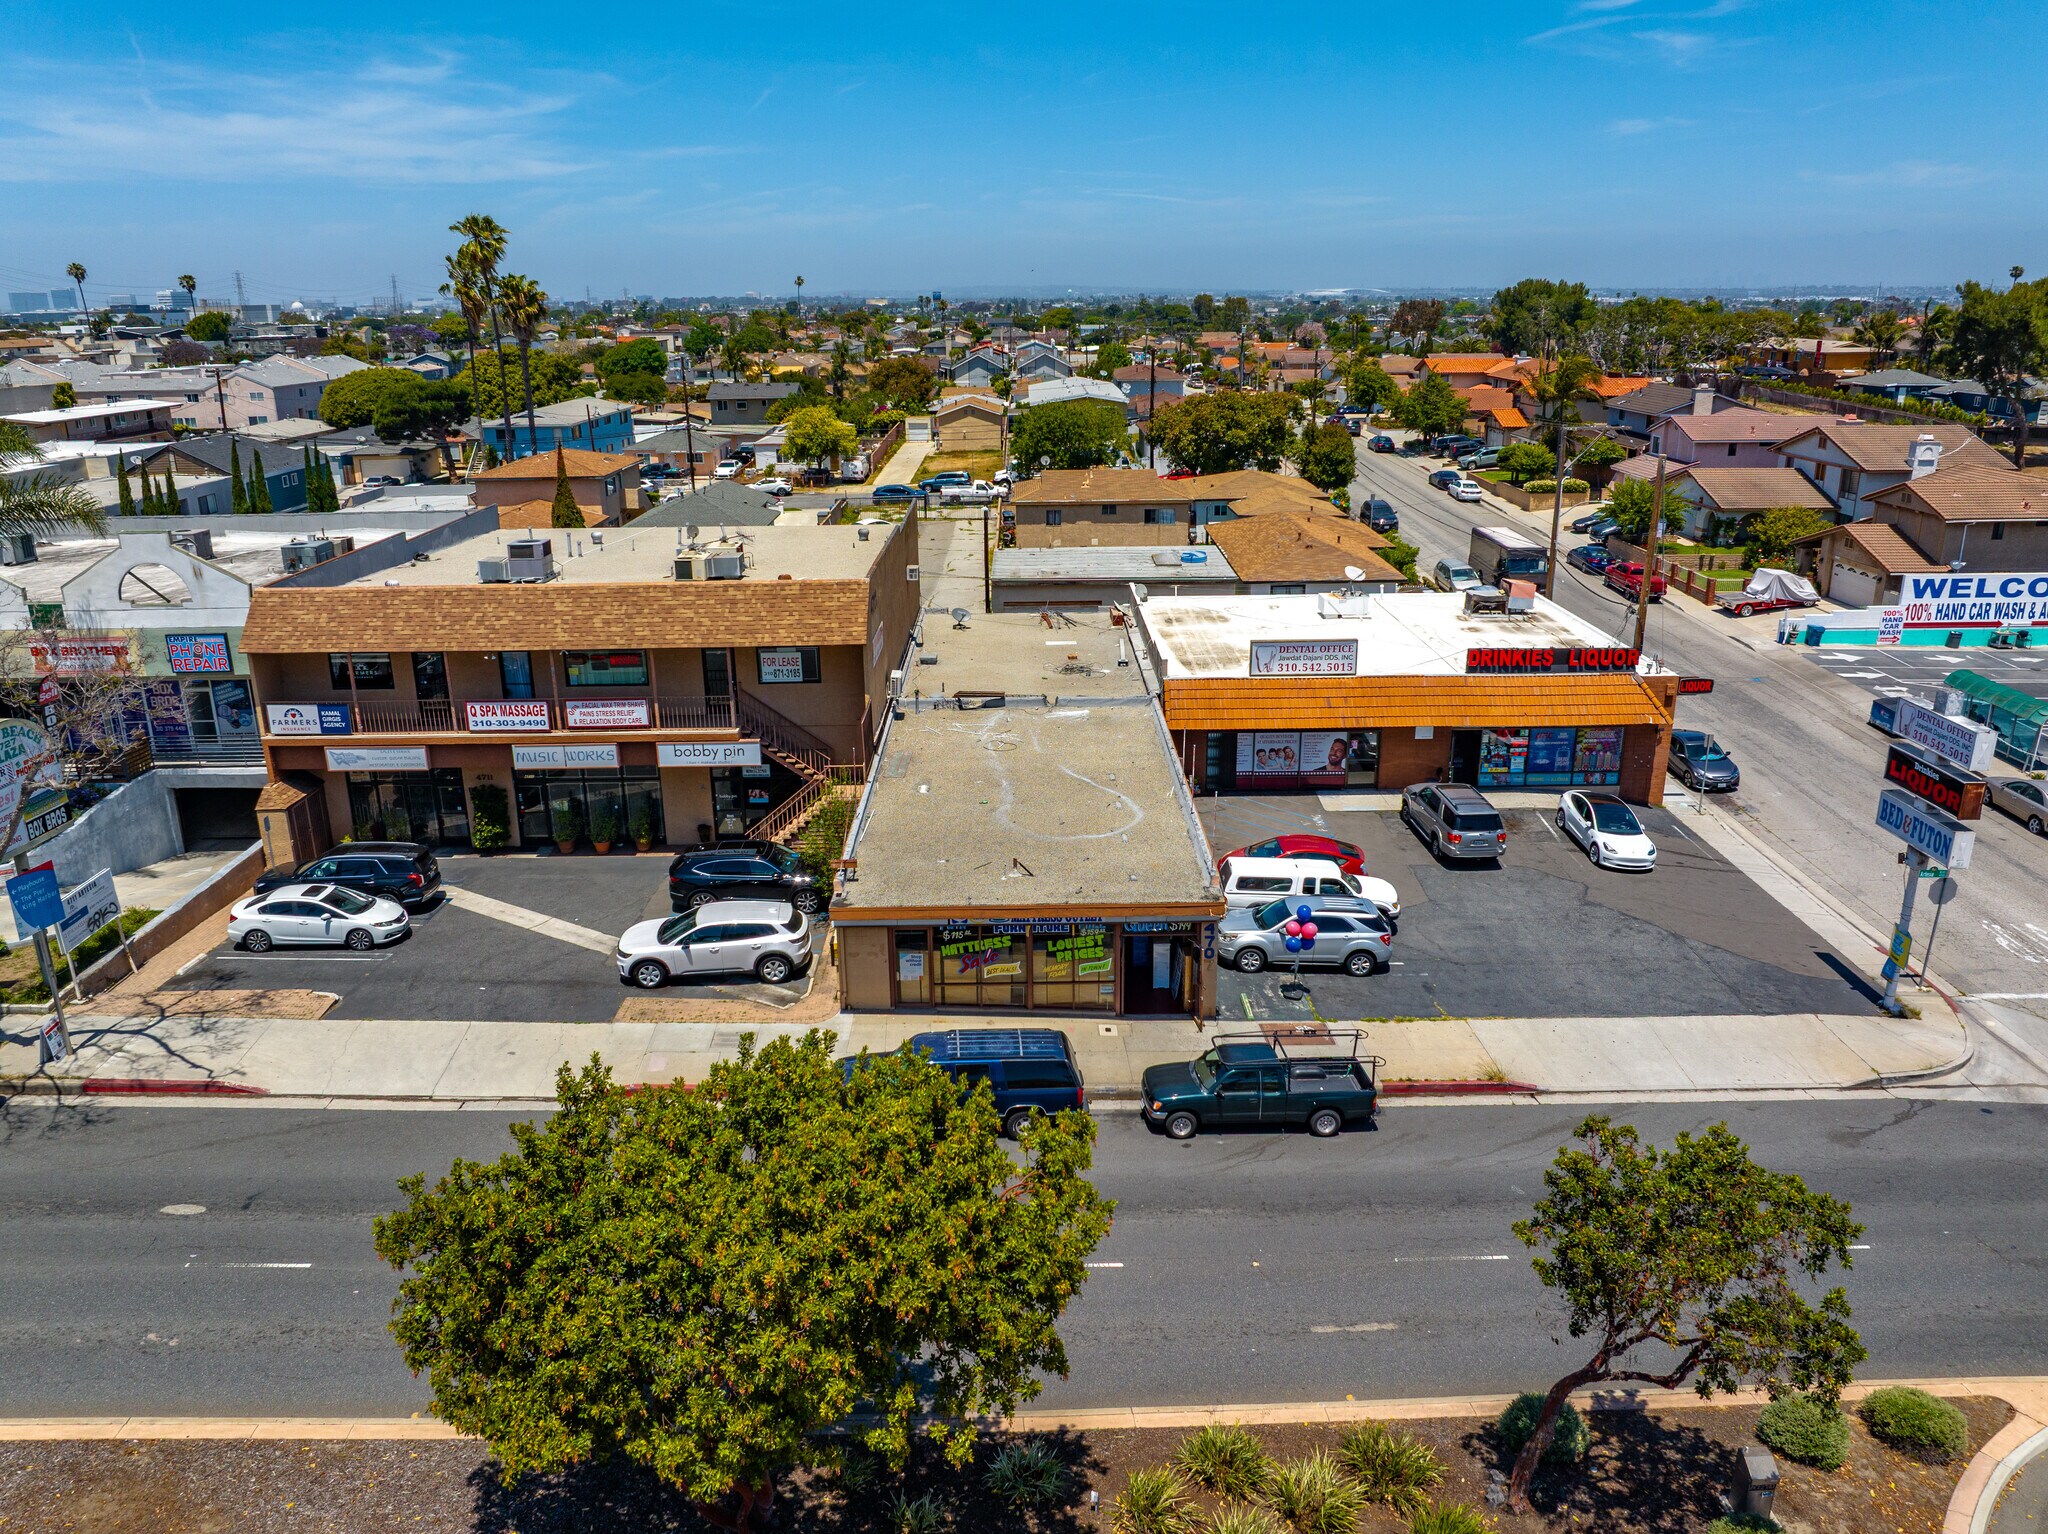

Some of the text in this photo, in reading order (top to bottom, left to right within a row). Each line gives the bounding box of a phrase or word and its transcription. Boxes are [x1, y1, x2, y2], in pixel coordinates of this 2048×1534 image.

[1905, 603, 1932, 621] 100%
[1935, 603, 1967, 621] HAND
[1968, 602, 1992, 620] CAR
[1993, 602, 2027, 620] WASH
[2028, 602, 2036, 619] &
[169, 643, 227, 656] PHONE
[1279, 645, 1354, 653] DENTAL OFFICE
[173, 657, 229, 671] REPAIR
[762, 657, 800, 667] FOR LEASE
[1468, 649, 1640, 667] DRINKIES LIQUOR
[773, 668, 801, 679] 871-3185
[1277, 663, 1353, 672] 310.542.5015
[39, 687, 58, 701] Sell
[152, 683, 175, 695] BOX
[1680, 680, 1713, 692] LIQUOR
[470, 704, 546, 718] Q SPA MASSAGE
[272, 719, 318, 727] FARMERS
[471, 719, 547, 727] 310-303-9490
[1916, 709, 1945, 731] DENTAL
[1946, 724, 1974, 744] OFFICE
[673, 744, 745, 760] bobby pin
[1912, 729, 1970, 765] 310.542.5015
[516, 749, 615, 763] MUSIC WORKS
[1914, 761, 1940, 781] Drinkies
[1889, 759, 1961, 811] LIQUOR
[28, 819, 45, 840] BOX
[45, 807, 67, 832] BROS
[17, 876, 45, 893] Playhouse
[78, 881, 97, 899] ARTESIA
[21, 888, 46, 903] The Pier
[22, 890, 57, 910] King Harbor
[941, 935, 1012, 957] MATTRESS
[1047, 934, 1104, 952] LOWEST
[958, 947, 1000, 975] Sale
[1056, 946, 1105, 963] PRICES
